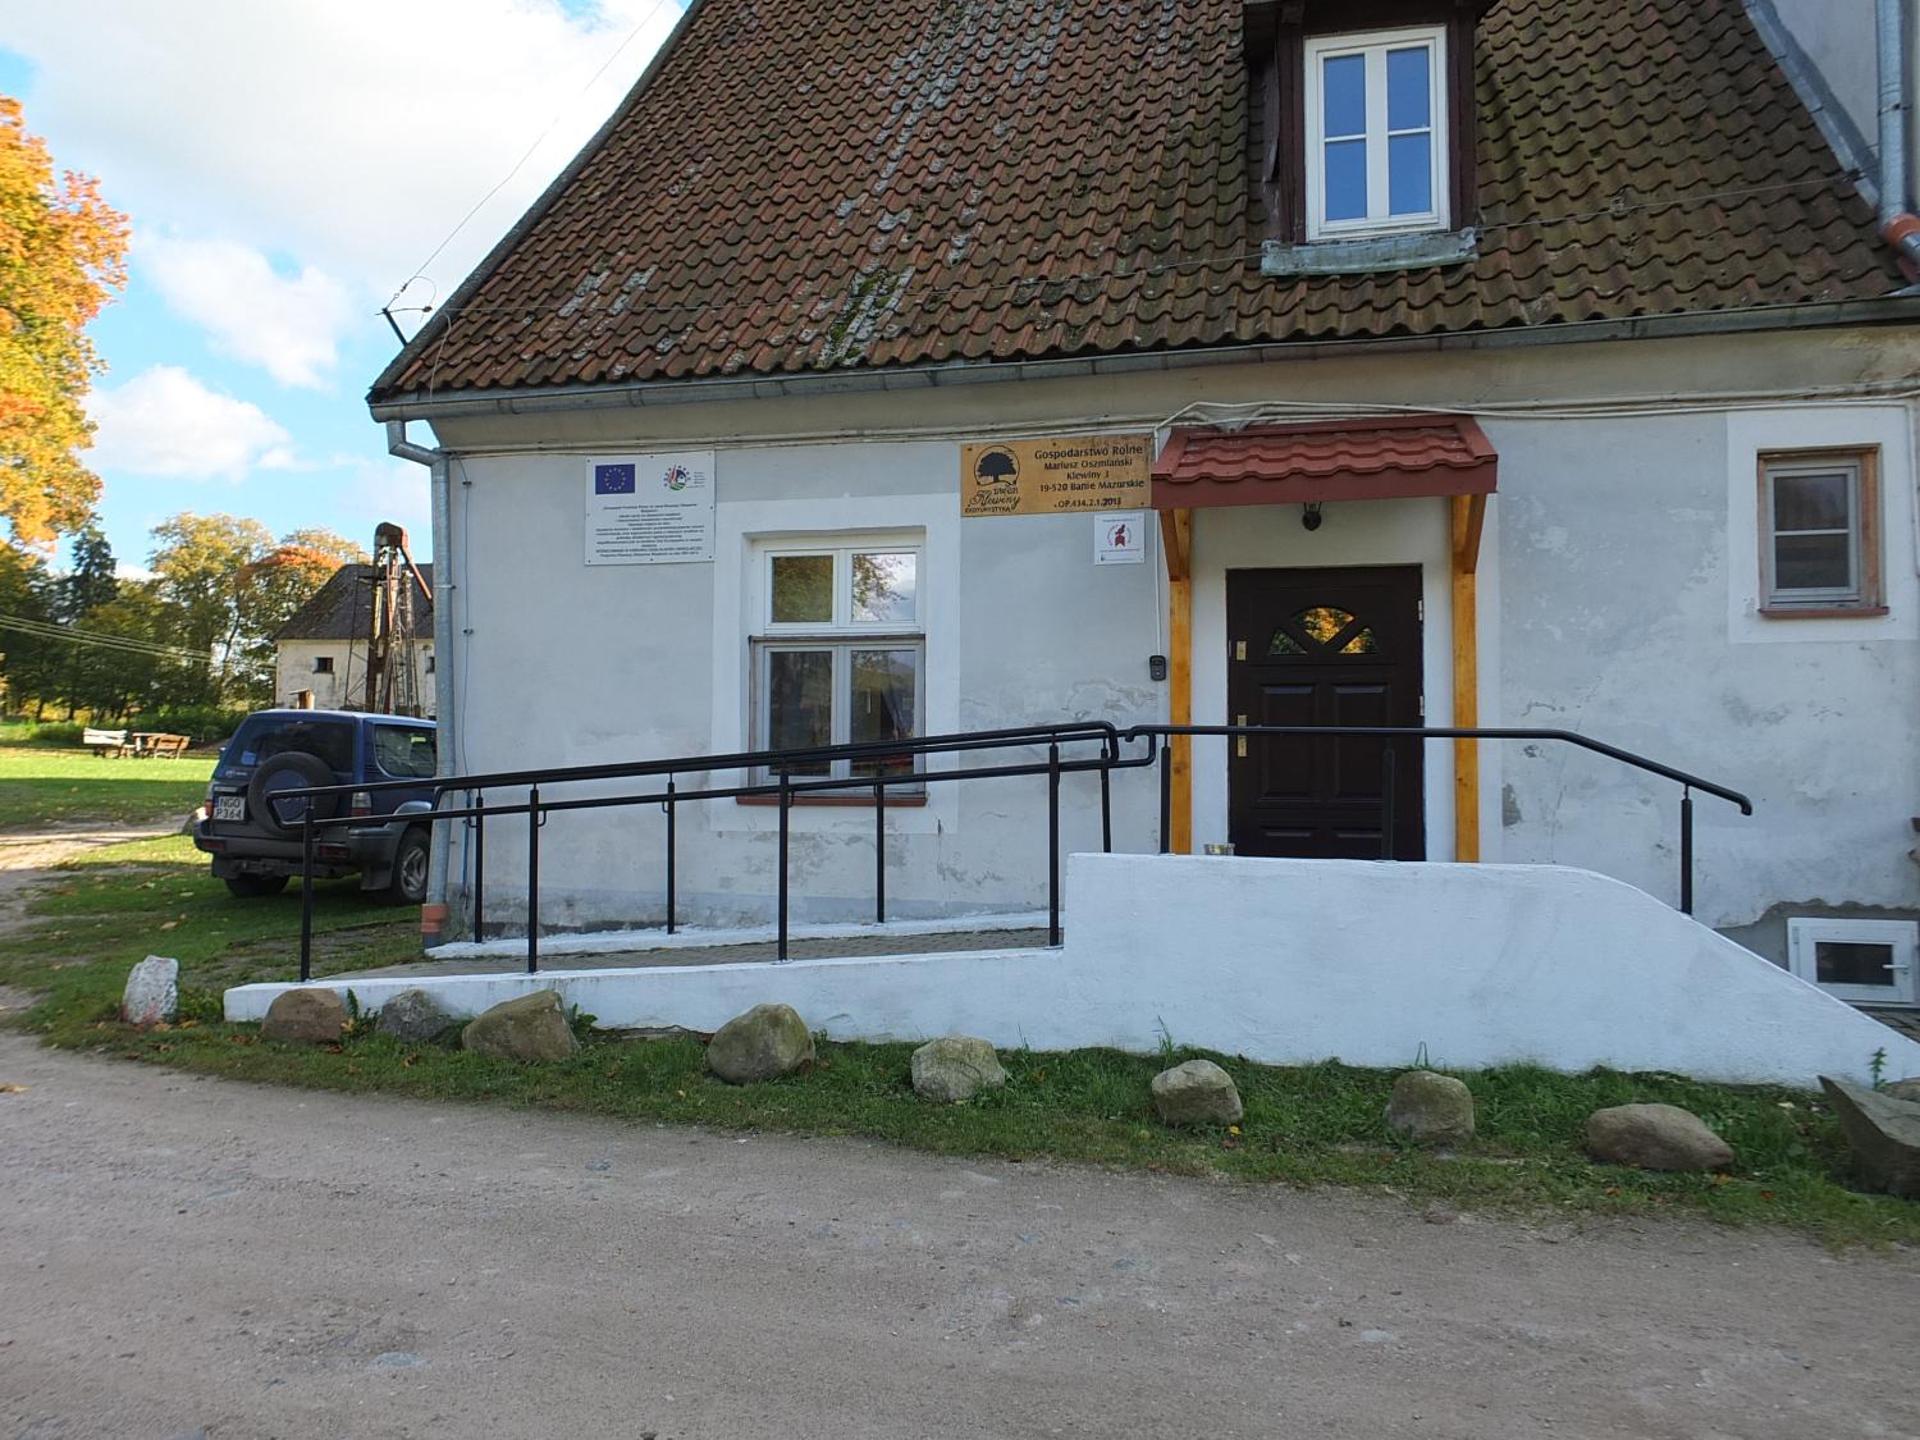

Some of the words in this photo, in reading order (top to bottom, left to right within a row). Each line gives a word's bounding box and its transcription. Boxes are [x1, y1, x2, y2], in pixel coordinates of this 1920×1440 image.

[1034, 446, 1109, 460] Gospodarstwo
[1112, 444, 1143, 456] Rolne
[1044, 460, 1079, 470] Mariusz
[1066, 470, 1101, 480] Klewiny
[1040, 482, 1068, 492] 19-520
[1070, 481, 1096, 491] Banie
[1098, 479, 1145, 490] Mazurskie
